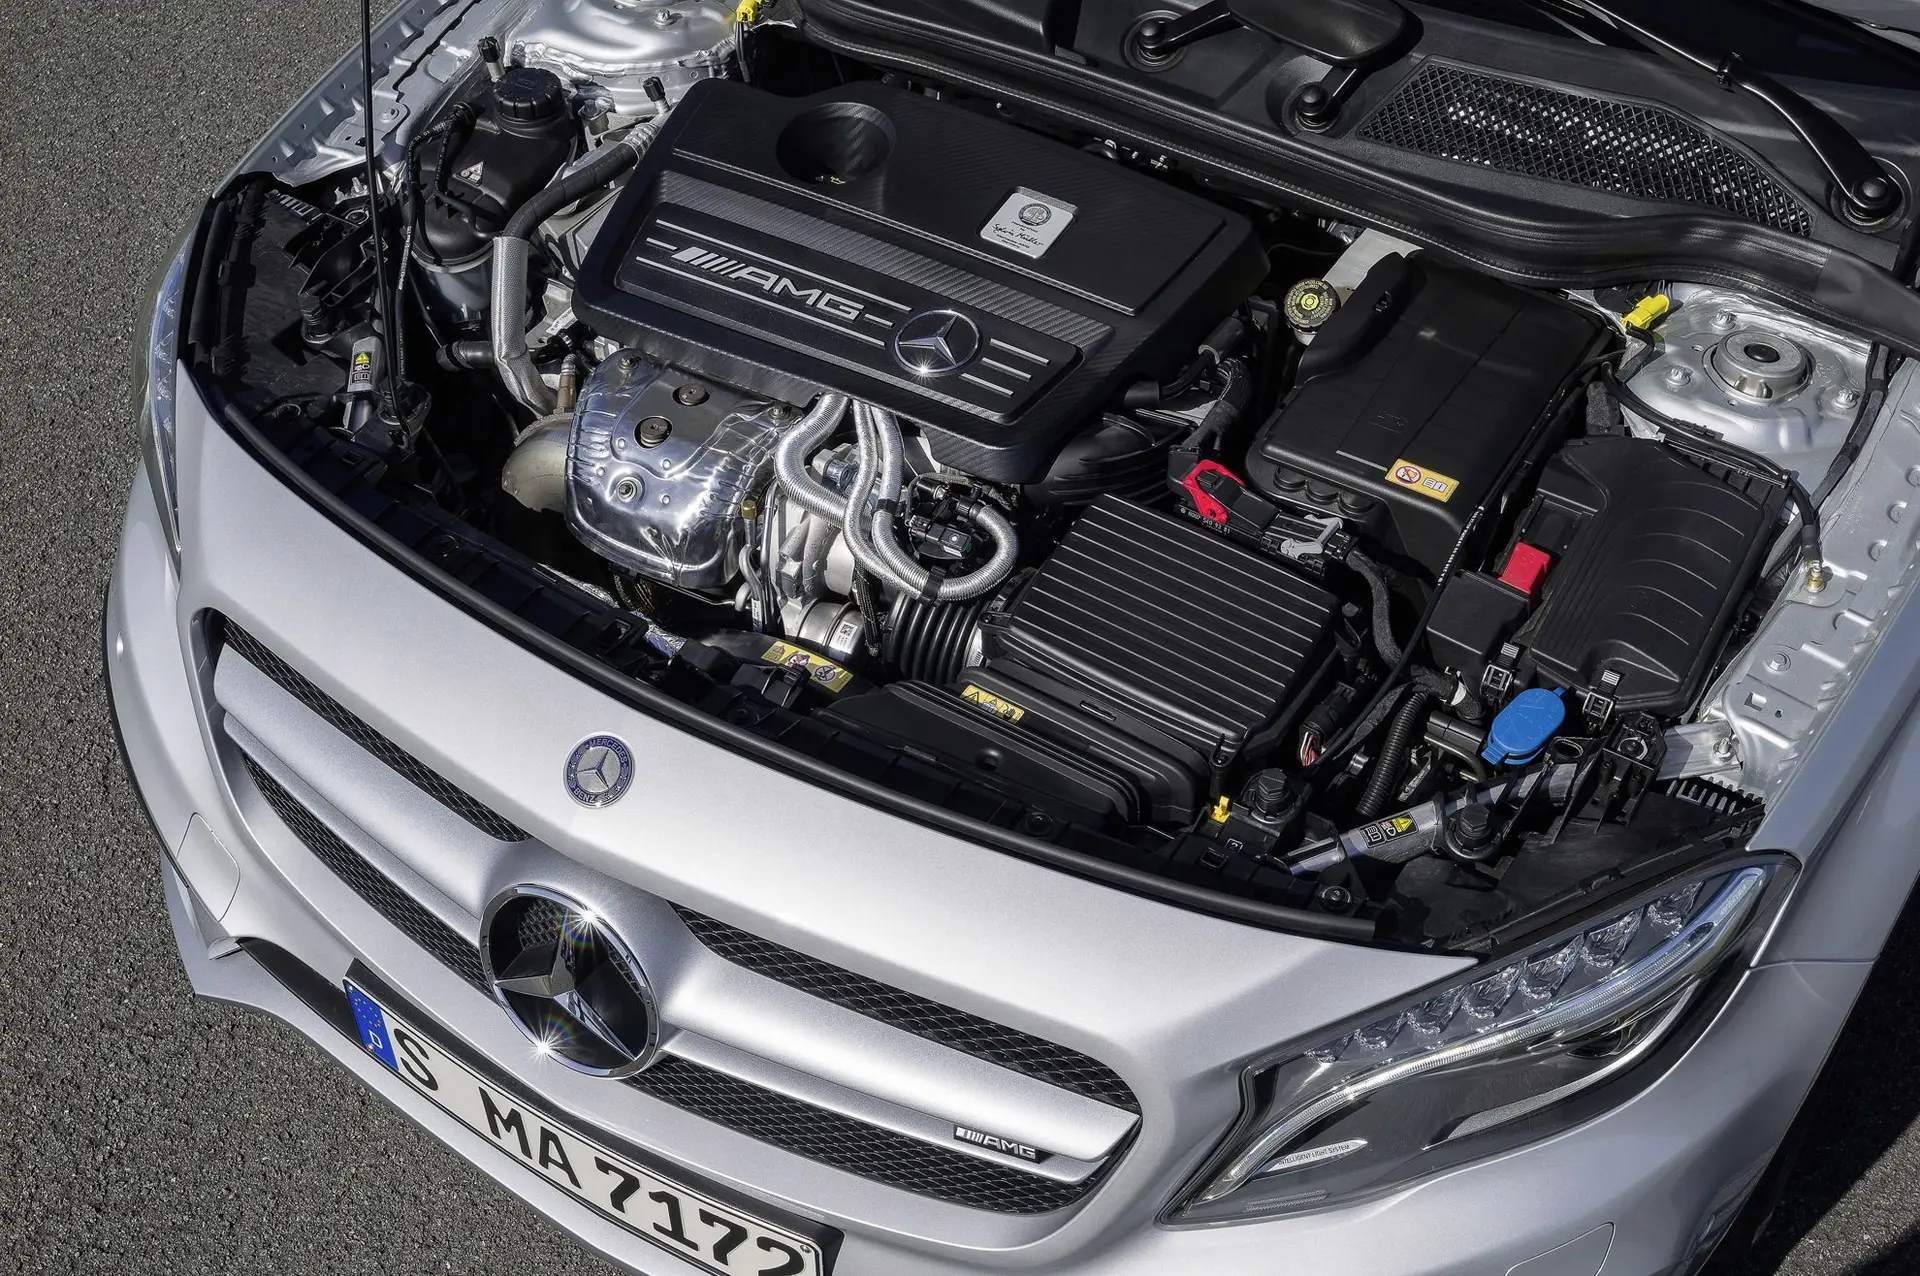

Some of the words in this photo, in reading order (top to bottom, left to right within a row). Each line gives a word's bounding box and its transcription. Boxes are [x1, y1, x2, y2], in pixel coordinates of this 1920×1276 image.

[727, 265, 866, 322] AMG
[588, 738, 628, 763] MERCEDES
[573, 787, 596, 803] BENZ
[369, 1028, 382, 1050] D
[394, 1028, 439, 1091] S
[478, 1086, 583, 1190] MA
[594, 1155, 806, 1276] 7172
[982, 1134, 1036, 1160] AMG
[1278, 1152, 1311, 1165] INTELLIGENT
[1311, 1148, 1328, 1158] LIGHT
[1328, 1144, 1351, 1155] SYSTEM
